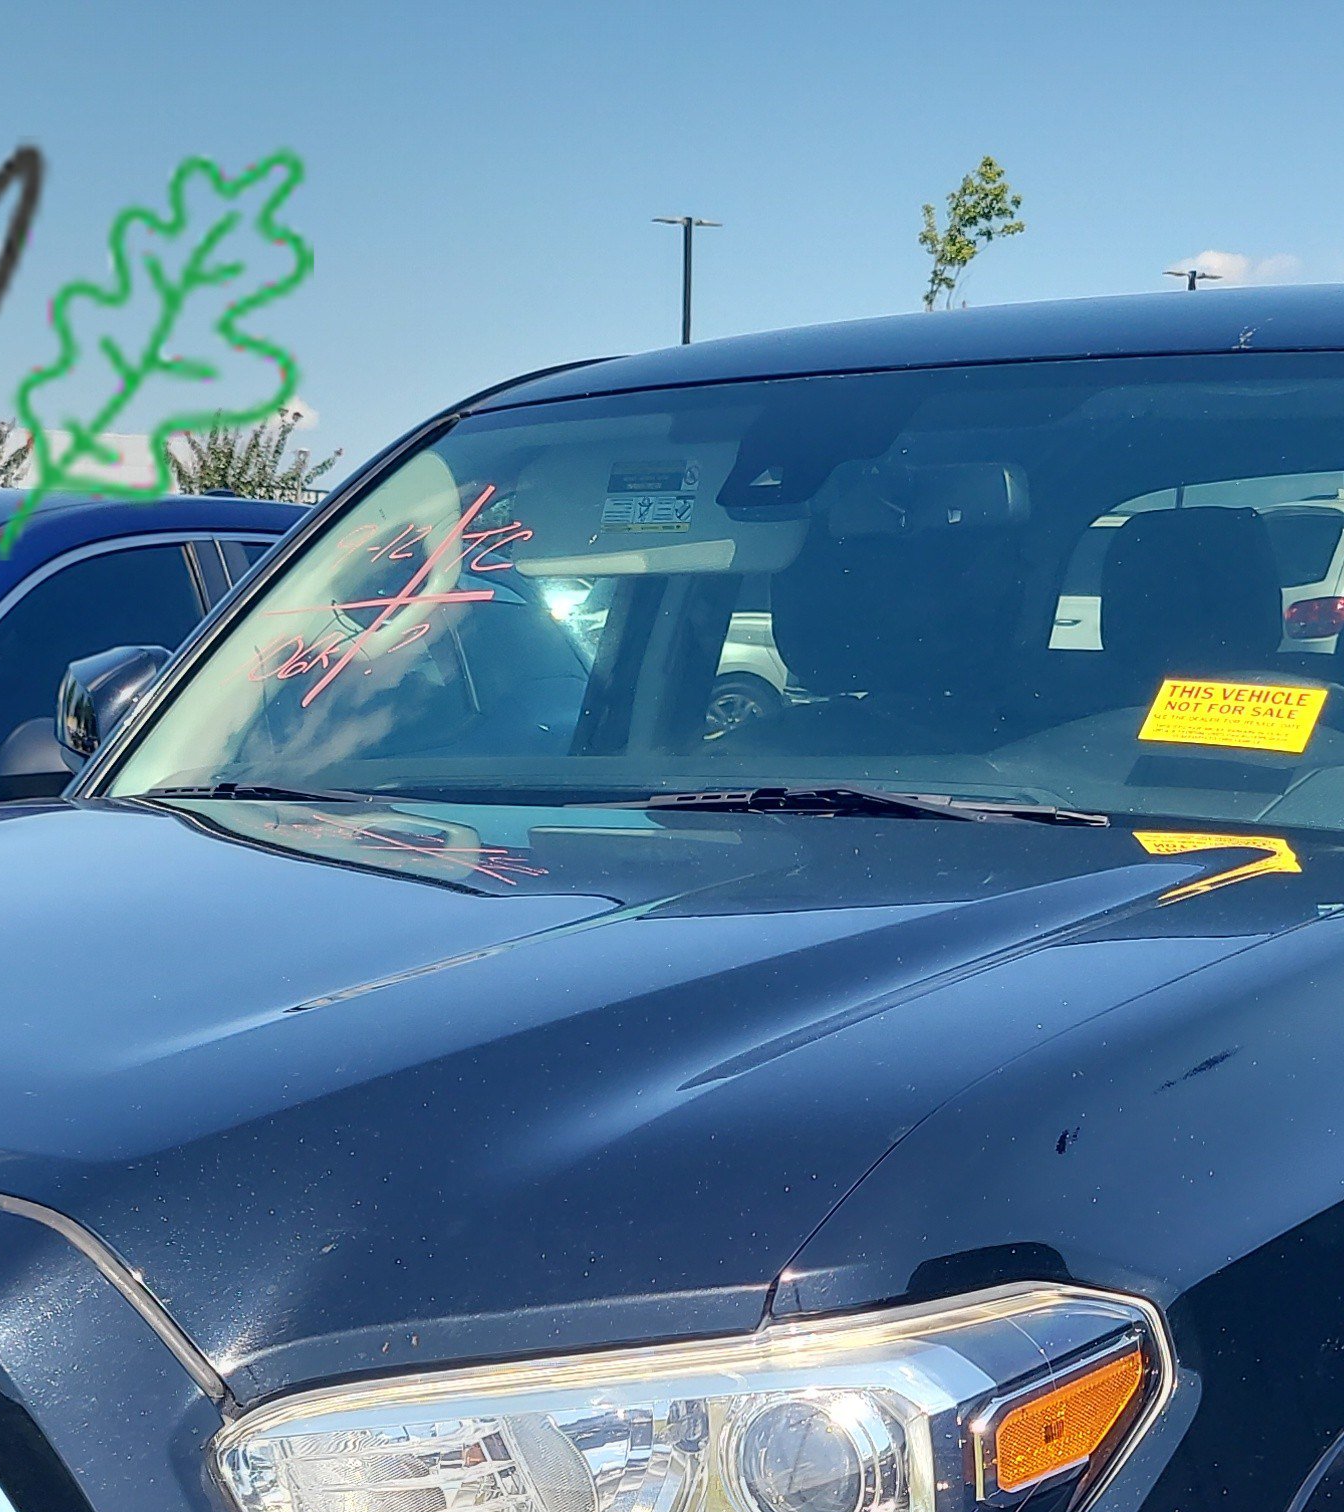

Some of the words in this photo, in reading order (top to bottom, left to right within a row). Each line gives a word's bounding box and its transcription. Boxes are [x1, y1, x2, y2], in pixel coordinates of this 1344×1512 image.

[1167, 685, 1215, 701] THIS
[1222, 688, 1311, 707] VEHICLE
[1164, 701, 1203, 714] NOT
[1207, 703, 1245, 716] FOR
[1250, 706, 1299, 720] SALE
